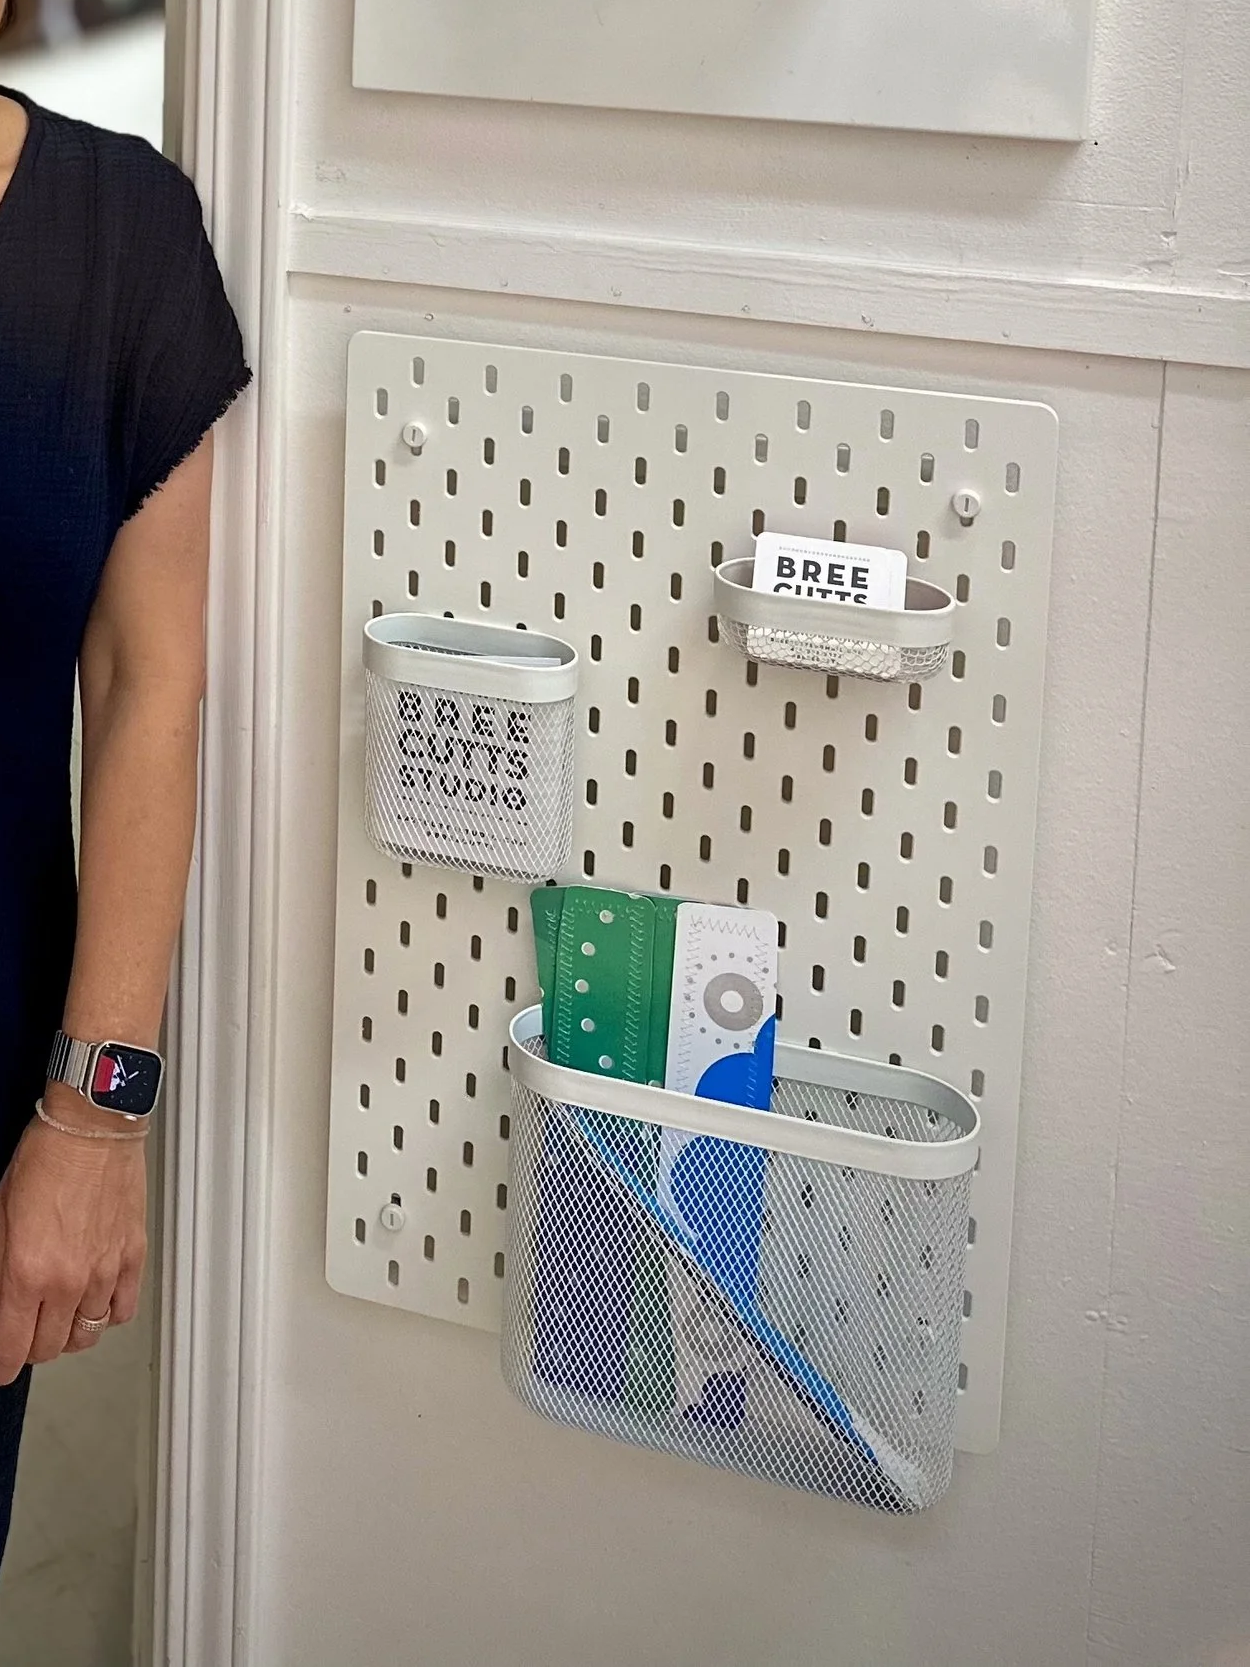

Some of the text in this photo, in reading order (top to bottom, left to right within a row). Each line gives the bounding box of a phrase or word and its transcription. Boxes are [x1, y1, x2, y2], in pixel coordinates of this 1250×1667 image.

[776, 555, 870, 591] BREE
[398, 690, 531, 744] BREE
[398, 728, 529, 780] CUTTS
[399, 764, 527, 811] STUDIO
